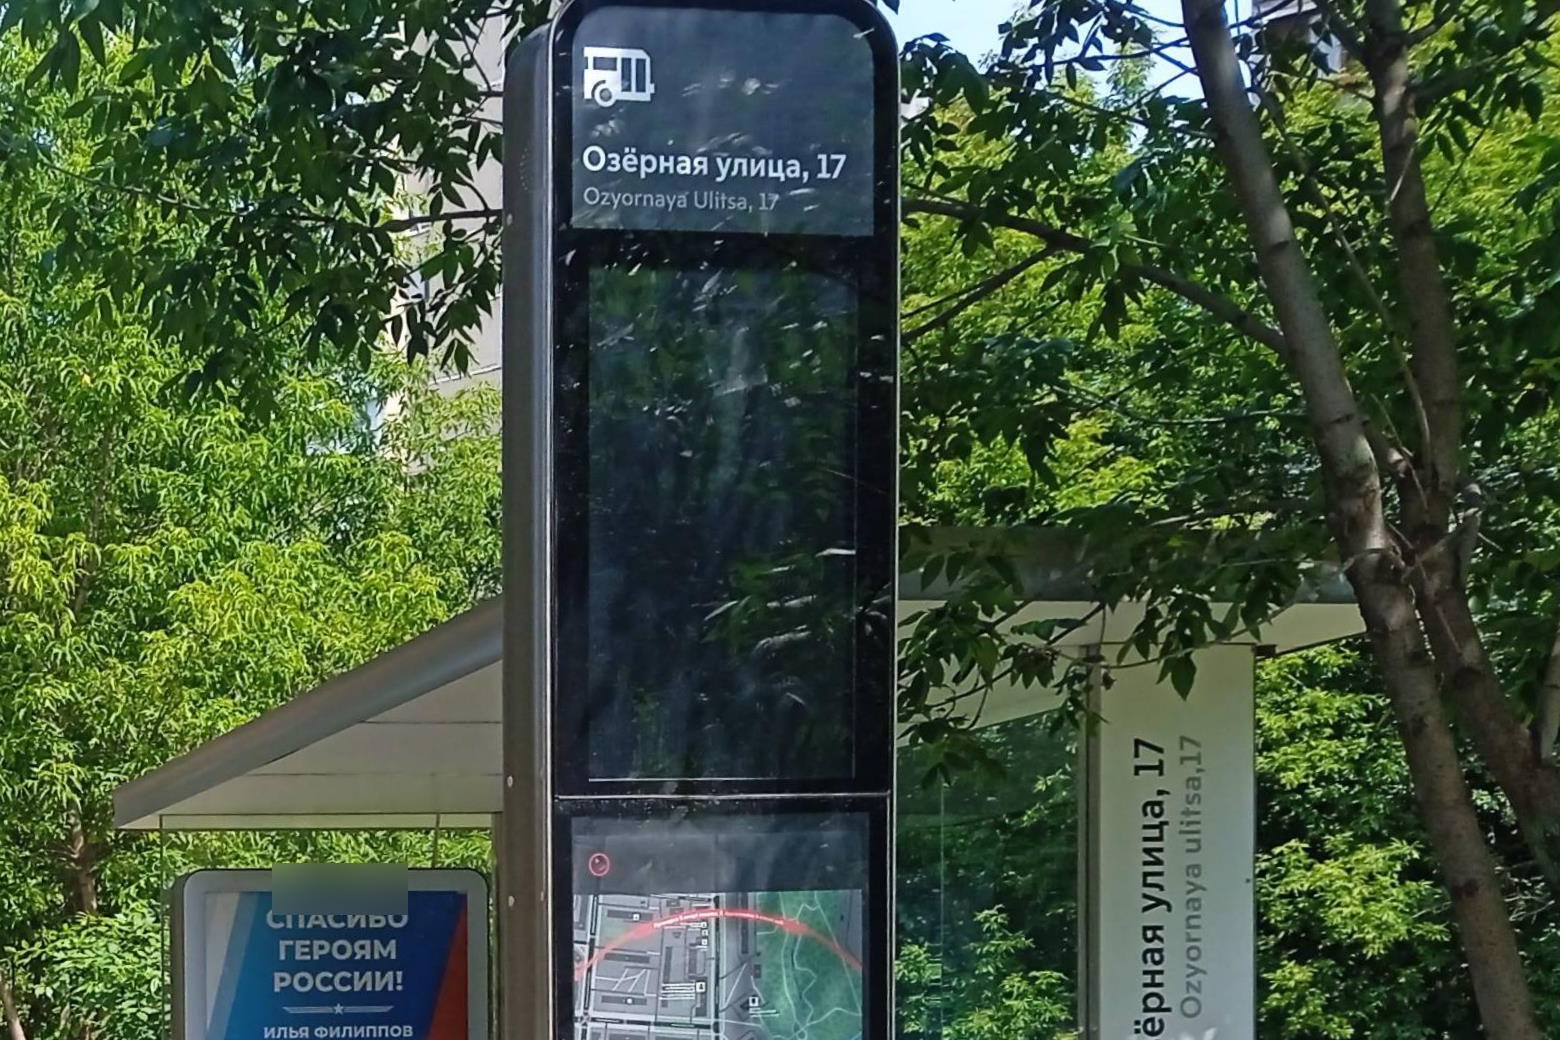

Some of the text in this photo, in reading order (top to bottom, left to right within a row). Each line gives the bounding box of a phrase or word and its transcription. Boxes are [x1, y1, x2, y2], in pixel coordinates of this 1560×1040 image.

[581, 144, 847, 183] Озёрная улица, 17
[583, 186, 779, 213] Ozyornaya Ulitsa, 17
[1133, 737, 1165, 777] 17
[1141, 788, 1172, 914] улица,
[278, 939, 398, 961] ГЕРОЯМ
[1179, 862, 1207, 1019] Ozyornaya
[273, 970, 404, 993] РОССИИ!
[263, 1025, 414, 1039] ИЛЬЯ ФИЛИППОВ
